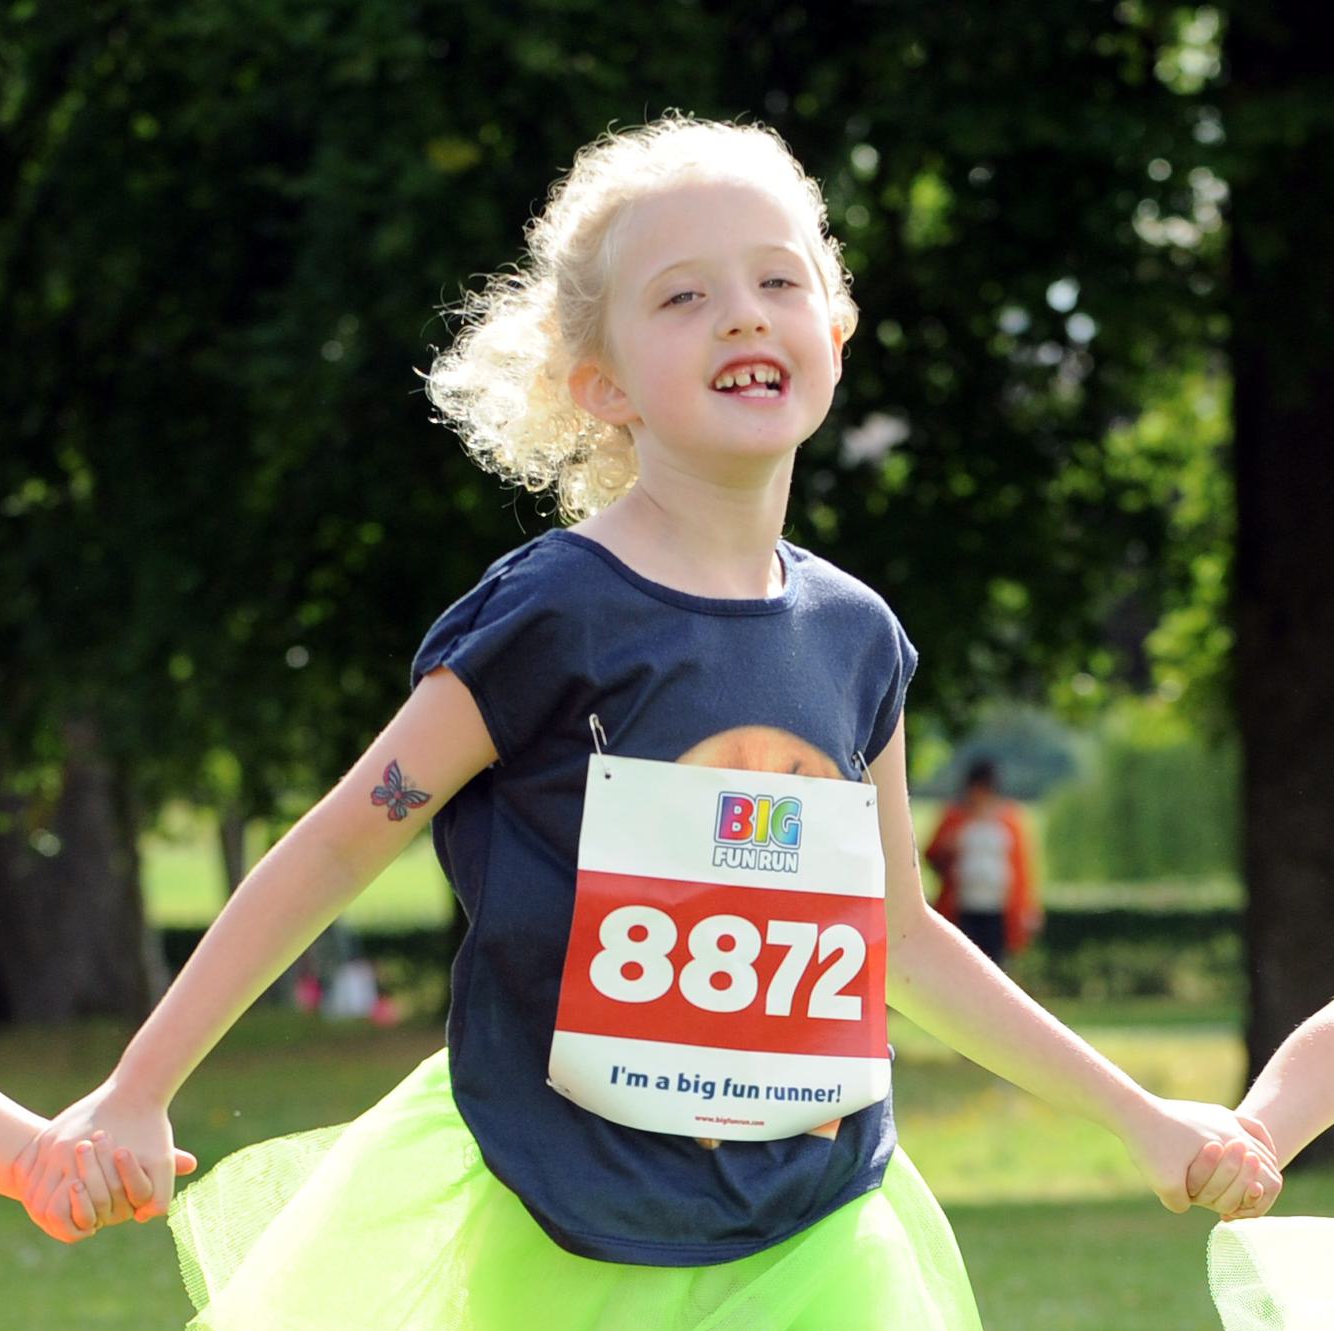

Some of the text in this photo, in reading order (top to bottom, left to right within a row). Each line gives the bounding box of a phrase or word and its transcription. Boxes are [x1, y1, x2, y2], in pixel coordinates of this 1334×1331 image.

[714, 791, 803, 850] BIG
[712, 845, 798, 873] FUN RUN
[589, 904, 867, 1021] 8872
[610, 1065, 842, 1104] I'm a big fun runner!
